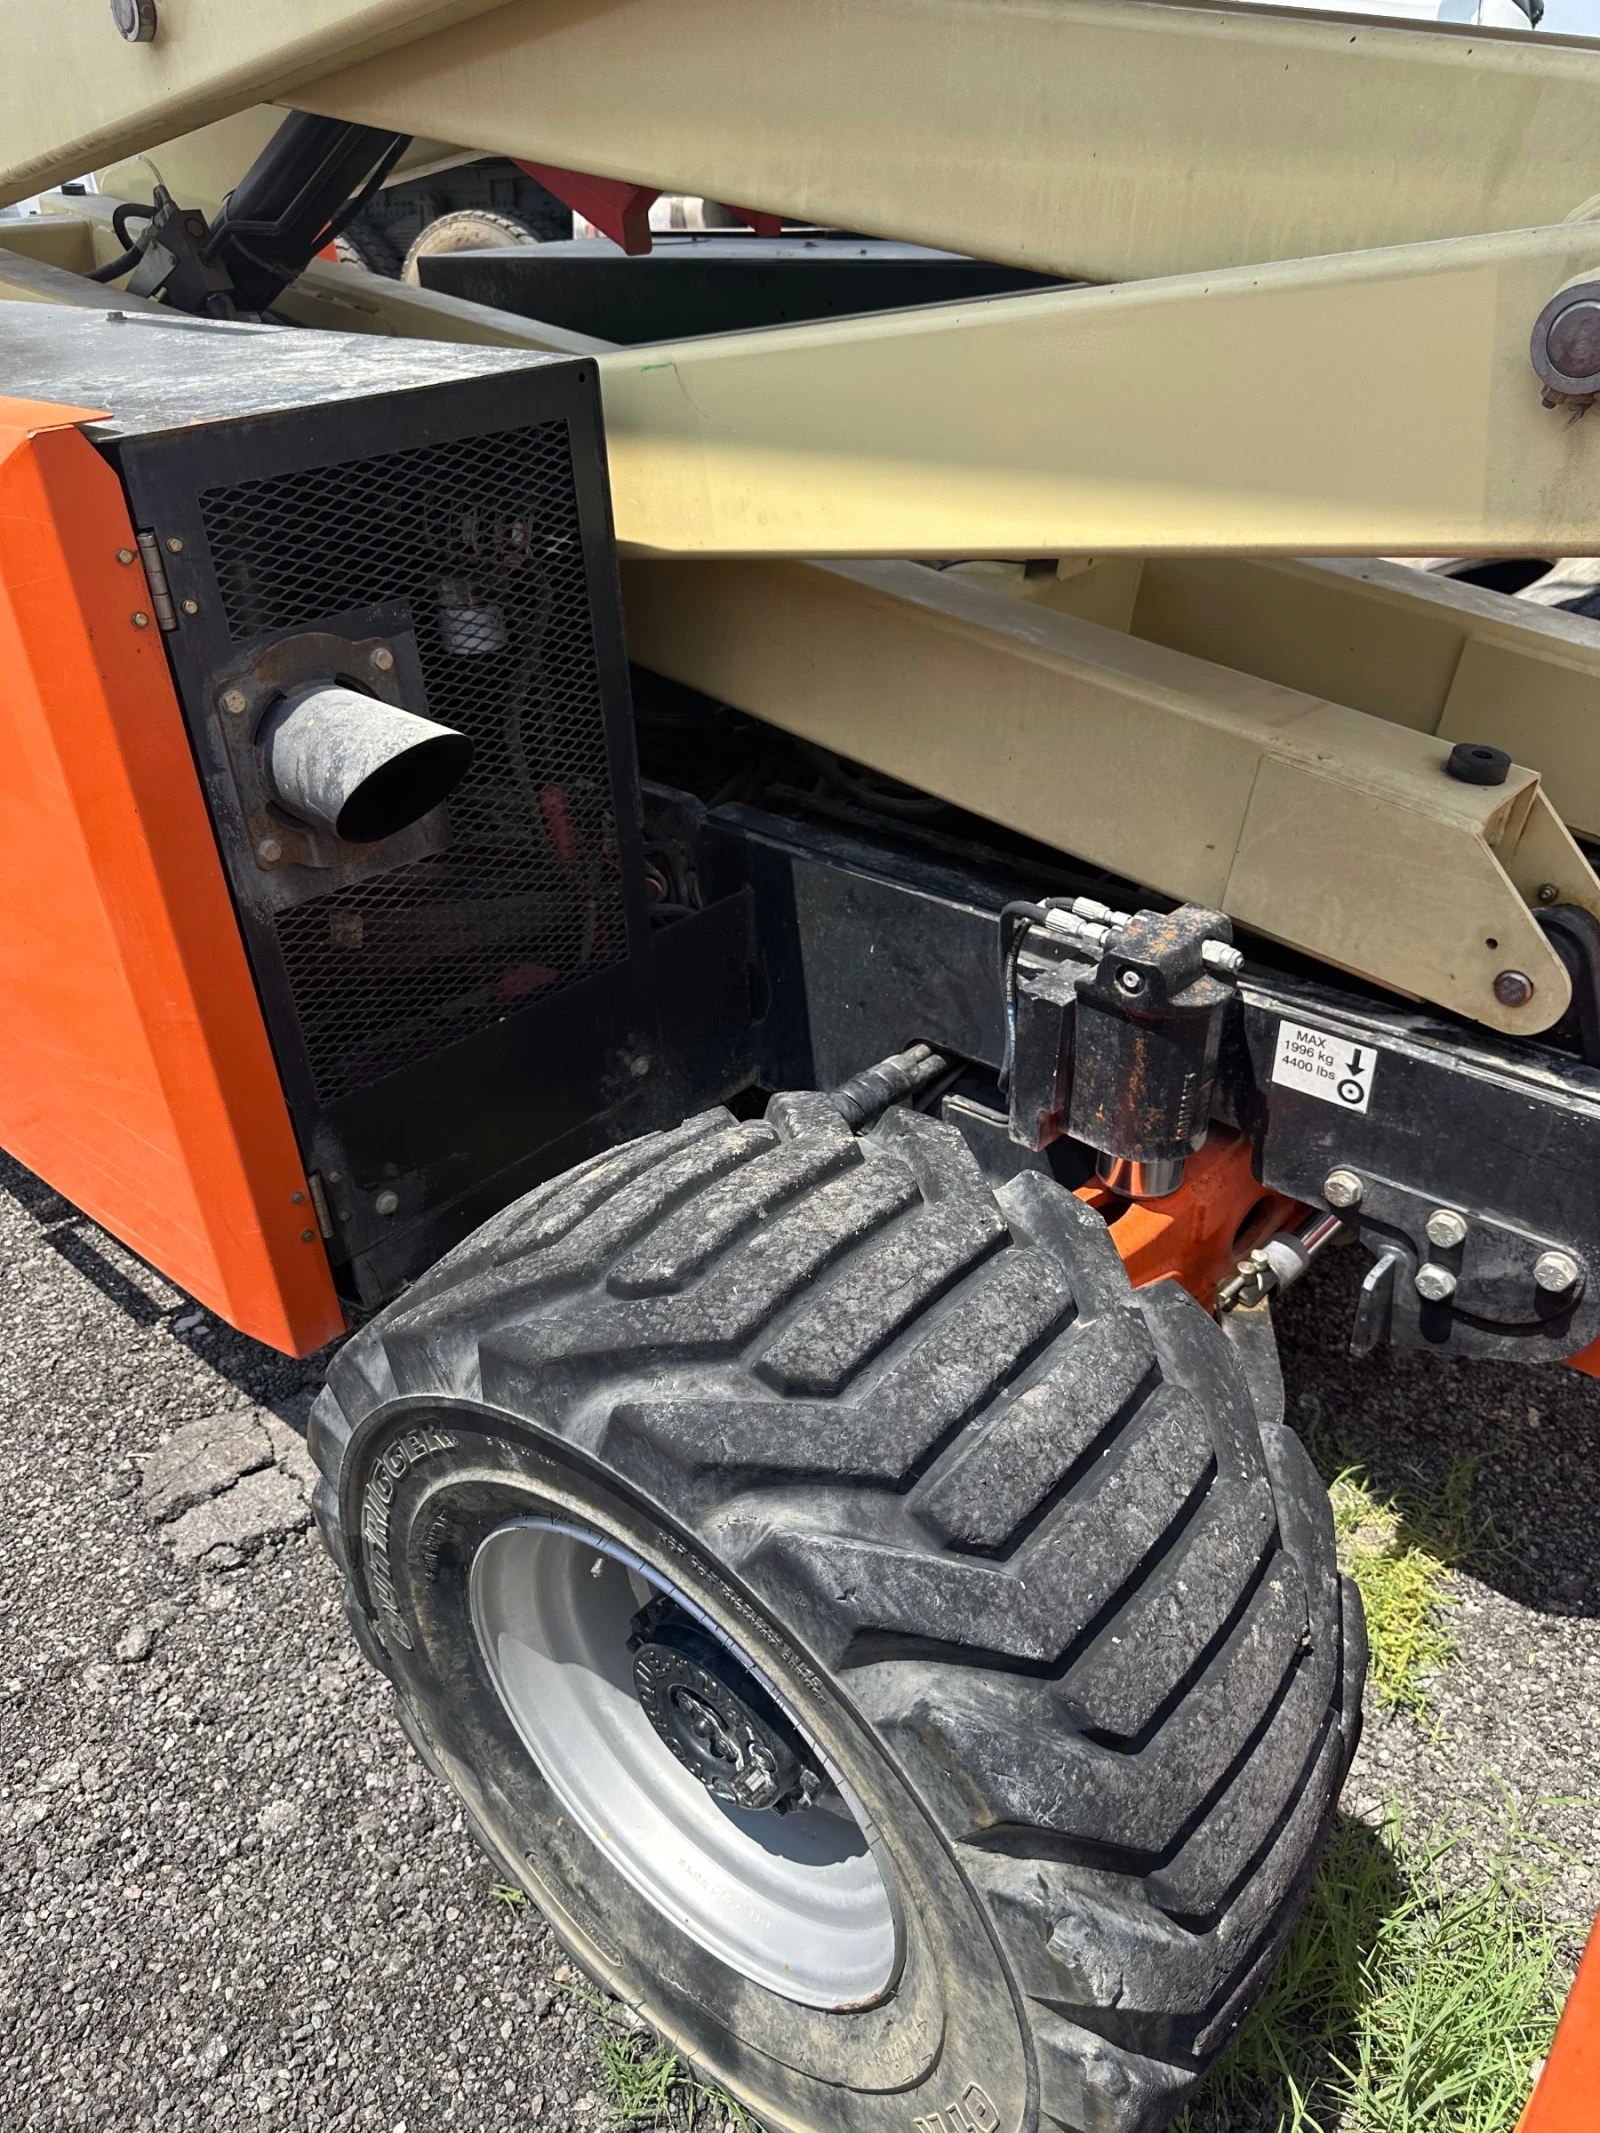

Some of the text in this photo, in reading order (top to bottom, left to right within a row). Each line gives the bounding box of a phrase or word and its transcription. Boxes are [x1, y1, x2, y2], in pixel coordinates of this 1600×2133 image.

[1296, 1030, 1327, 1049] MAX
[1285, 1040, 1334, 1066] 1996 kg
[1281, 1055, 1336, 1080] 4400 lbs
